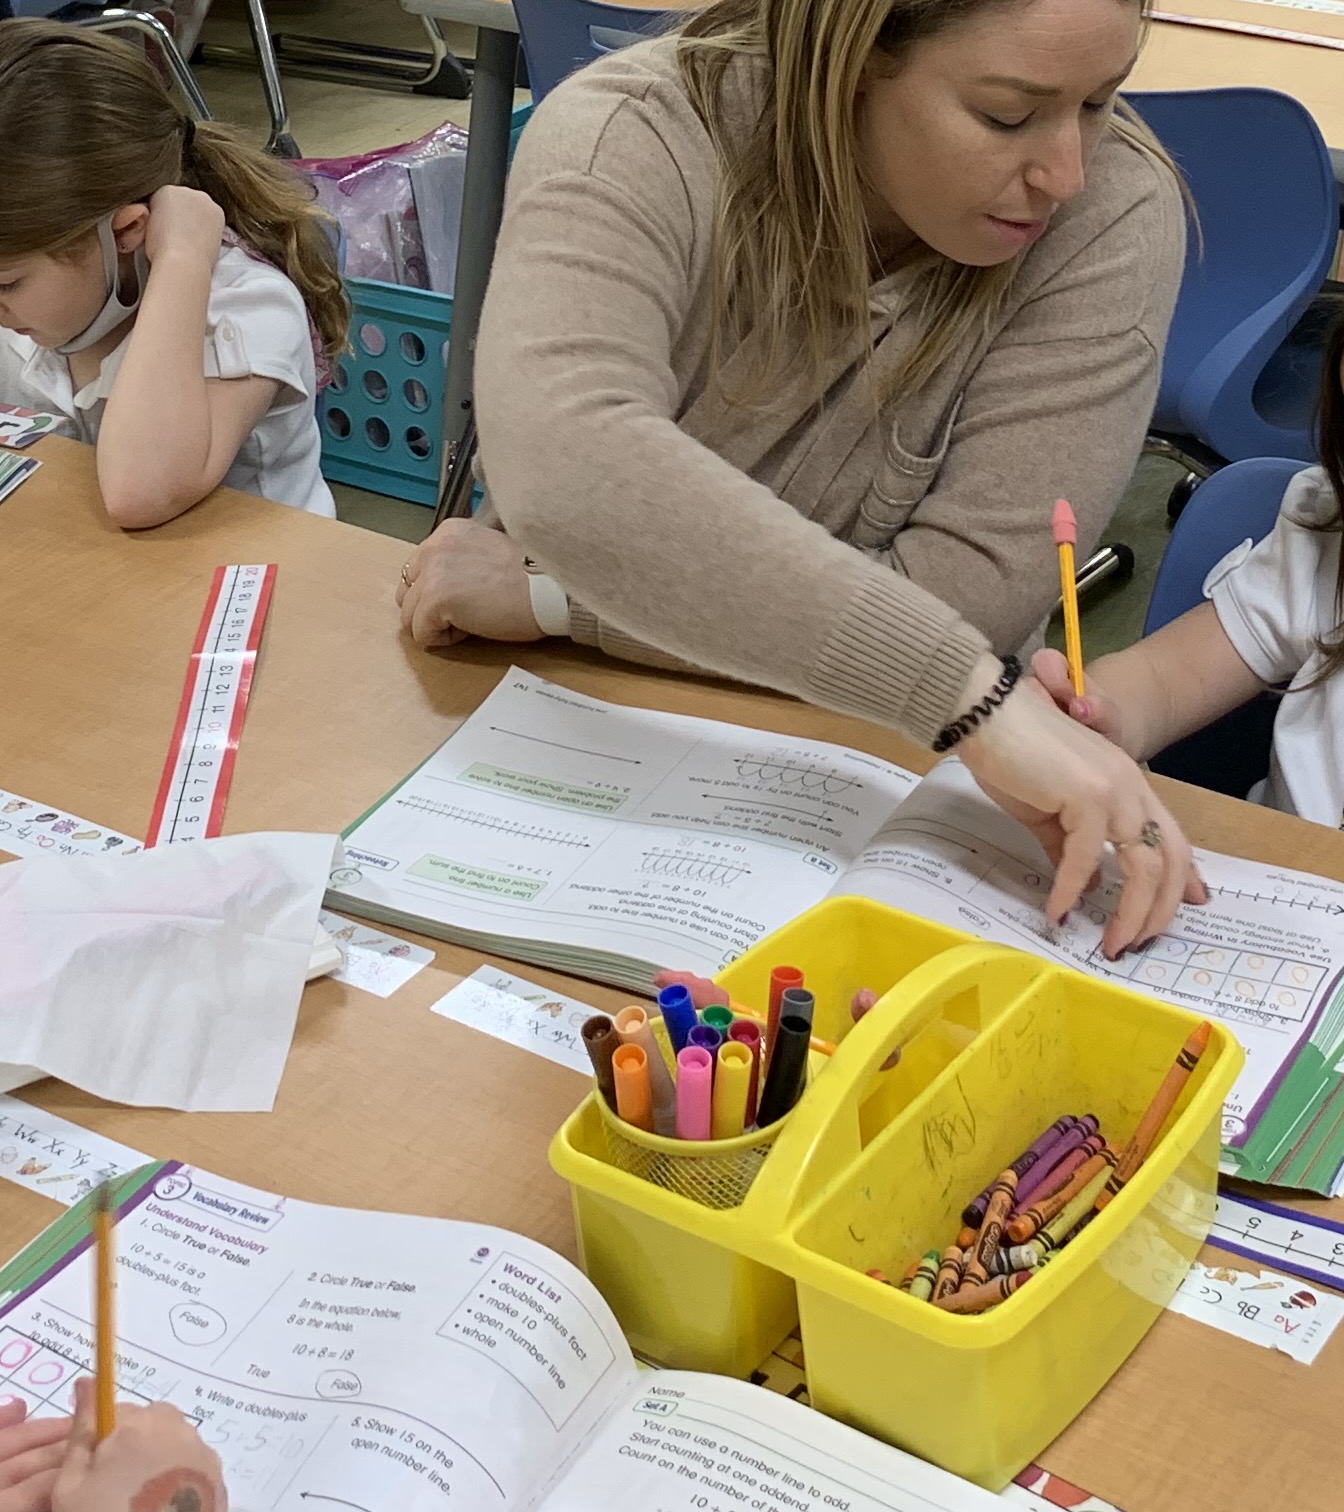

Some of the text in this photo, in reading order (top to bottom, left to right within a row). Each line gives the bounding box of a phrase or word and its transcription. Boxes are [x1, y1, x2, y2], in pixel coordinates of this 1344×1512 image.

[192, 1191, 271, 1225] Vocabulary Review
[1246, 1217, 1261, 1230] 5
[145, 1202, 268, 1254] Understand Vocabulary
[151, 1222, 181, 1241] Circle
[182, 1234, 207, 1251] True
[207, 1244, 220, 1255] or
[1290, 1228, 1304, 1240] 4
[116, 1255, 178, 1289] doubles-plus
[502, 1261, 562, 1303] Word List
[179, 1311, 209, 1329] False
[486, 1294, 537, 1331] make 10
[498, 1280, 587, 1361] doubles-plus fact
[461, 1325, 497, 1349] whole
[474, 1309, 567, 1390] open number line
[647, 1386, 685, 1399] Name
[350, 1437, 379, 1453] open
[378, 1444, 428, 1474] number
[363, 1419, 454, 1469] Show 15 on the
[642, 1419, 666, 1433] You
[667, 1427, 692, 1439] can
[694, 1433, 717, 1449] use
[718, 1444, 729, 1454] a
[730, 1449, 780, 1478] number
[780, 1472, 806, 1490] line
[806, 1484, 822, 1498] to
